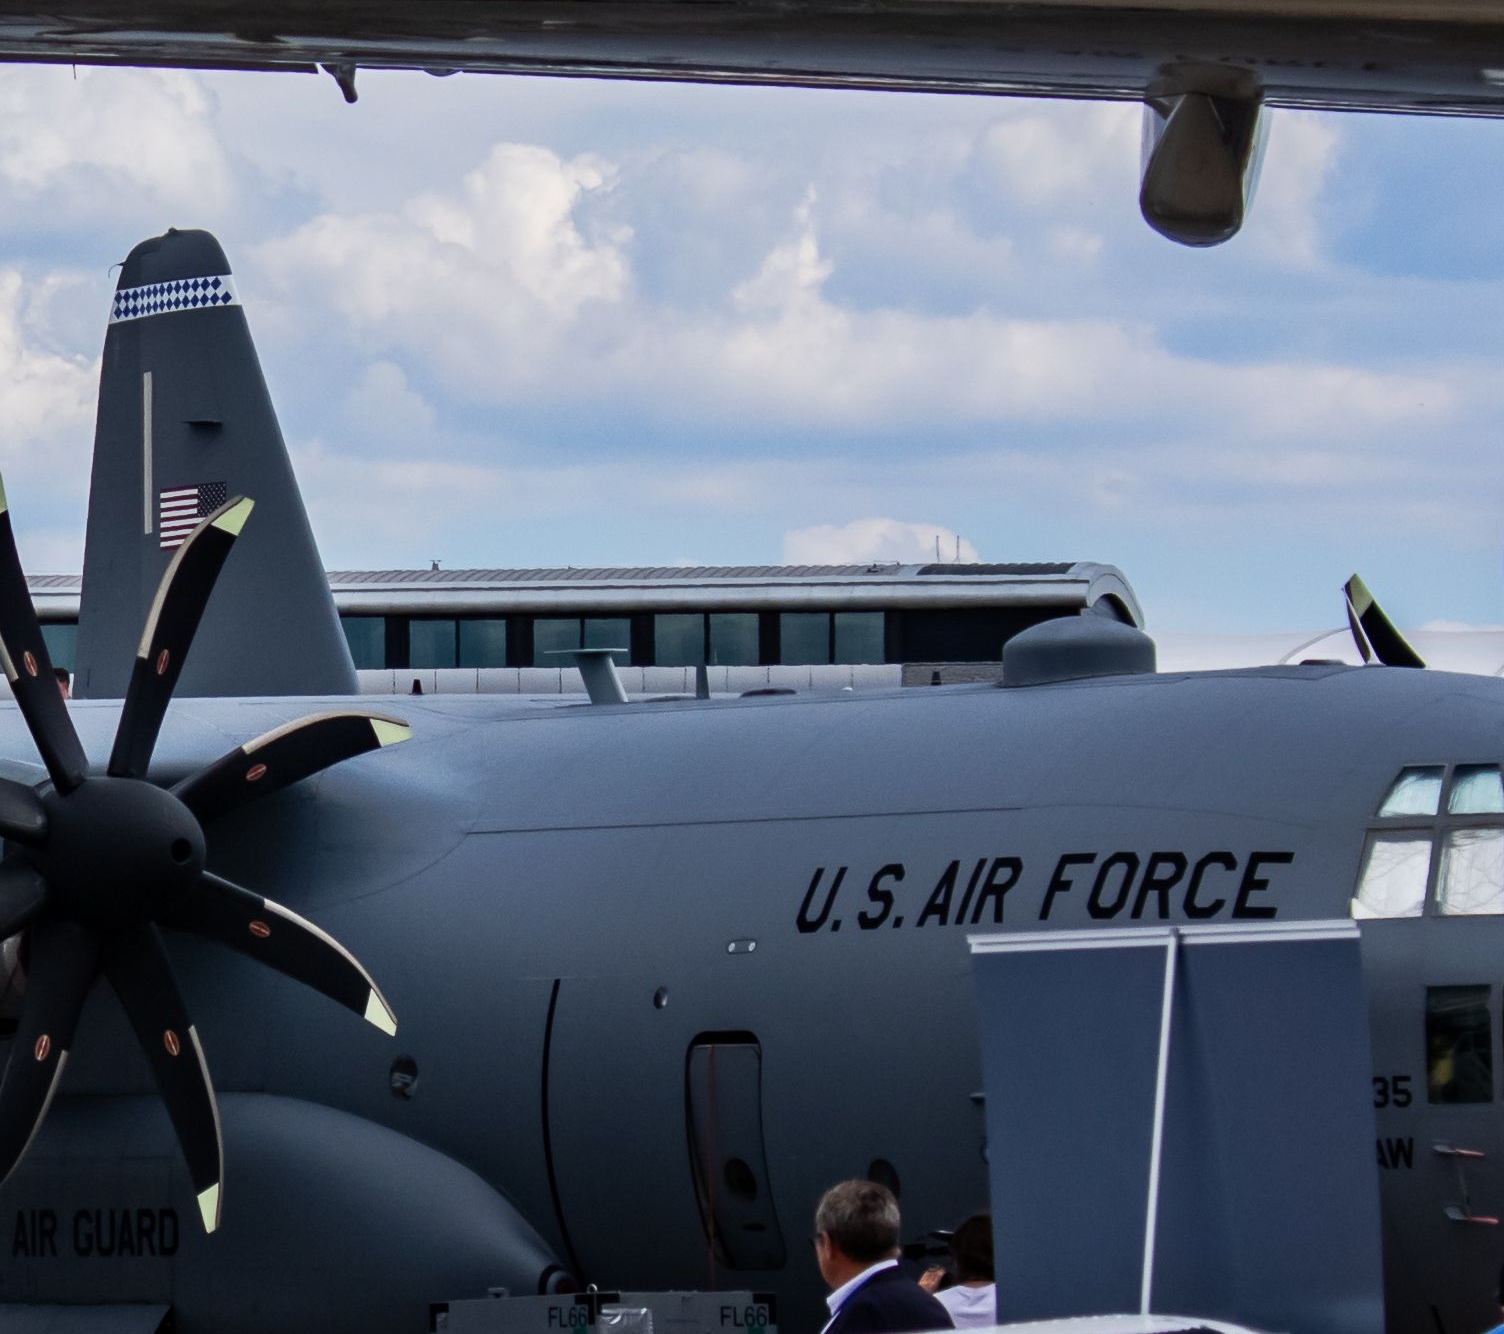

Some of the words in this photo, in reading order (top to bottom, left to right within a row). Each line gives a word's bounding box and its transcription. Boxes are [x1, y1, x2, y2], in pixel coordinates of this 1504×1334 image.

[796, 863, 906, 934] U.S.
[917, 856, 1024, 928] AIR
[1039, 850, 1295, 922] FORCE
[11, 1210, 59, 1258] AIR
[72, 1207, 180, 1258] GUARD
[548, 1307, 588, 1329] FL66
[720, 1305, 769, 1328] FL66
